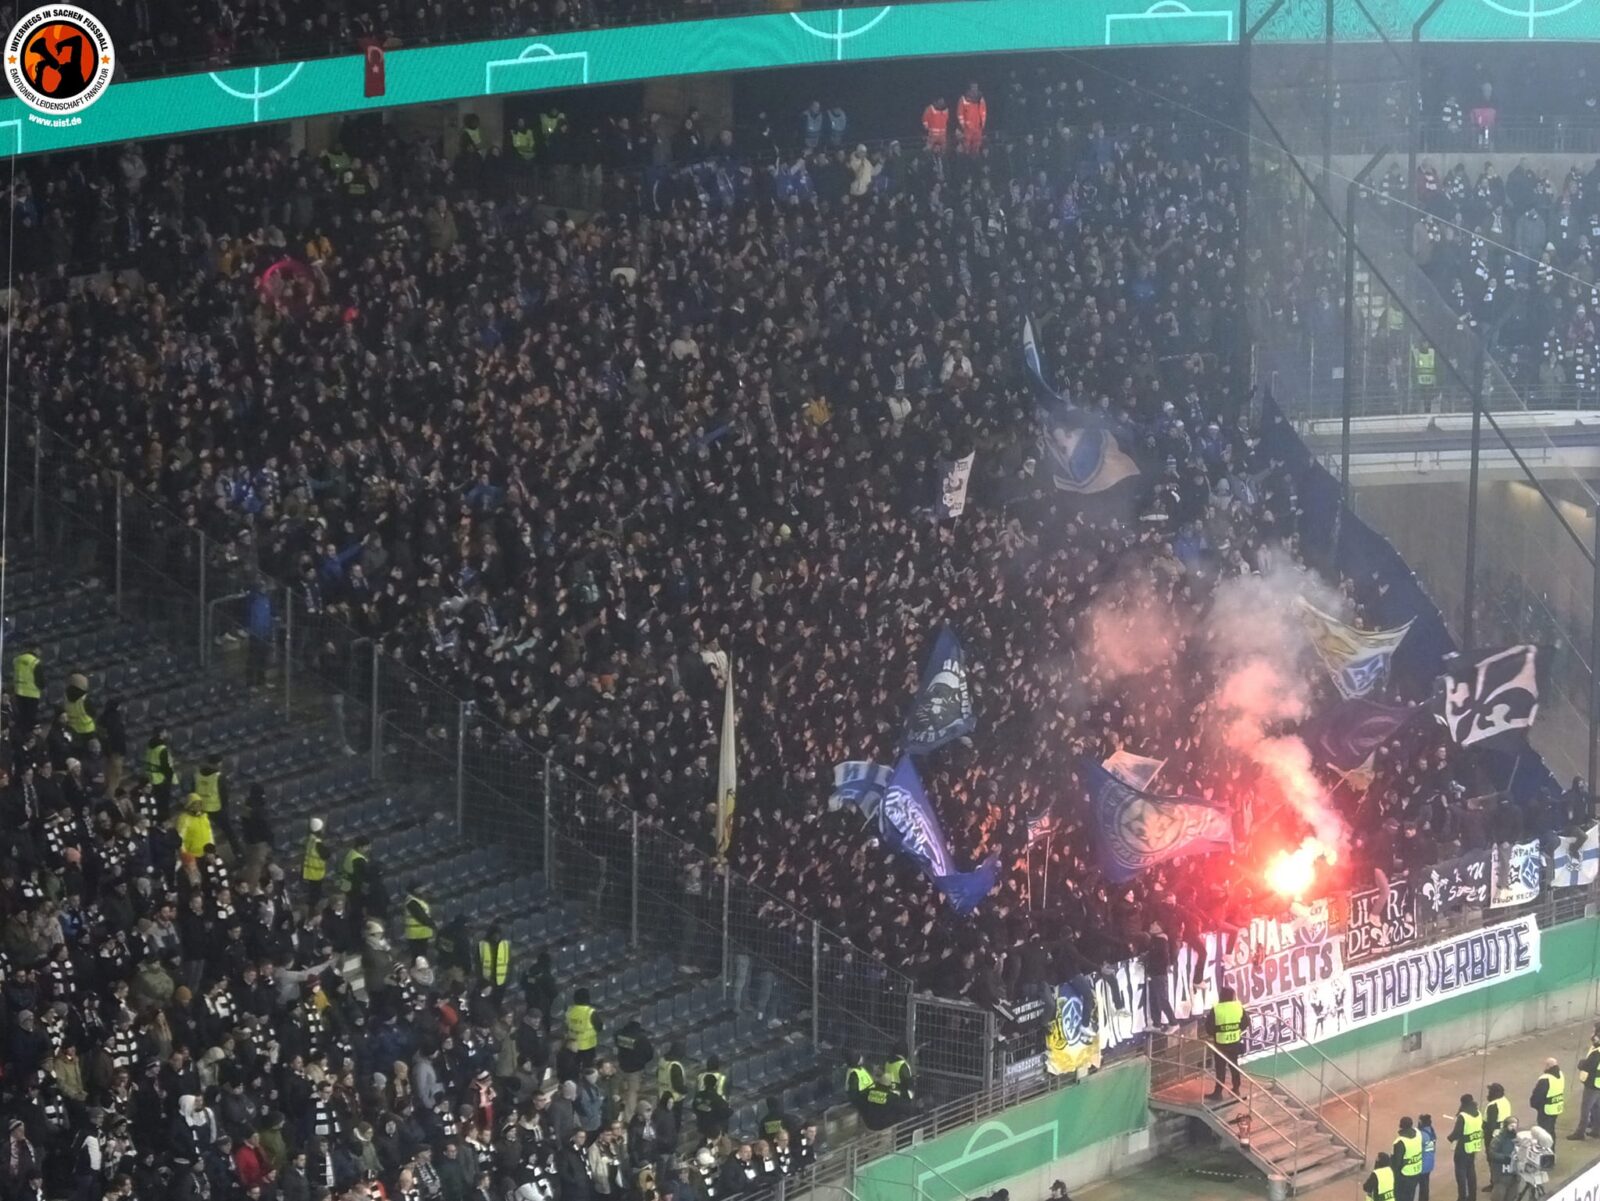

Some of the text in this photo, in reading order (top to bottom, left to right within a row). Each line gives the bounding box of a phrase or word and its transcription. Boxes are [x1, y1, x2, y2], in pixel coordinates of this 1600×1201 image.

[1348, 925, 1371, 955] DE
[1350, 922, 1531, 1022] STADTVERBOTE
[1242, 994, 1306, 1055] EGEN
